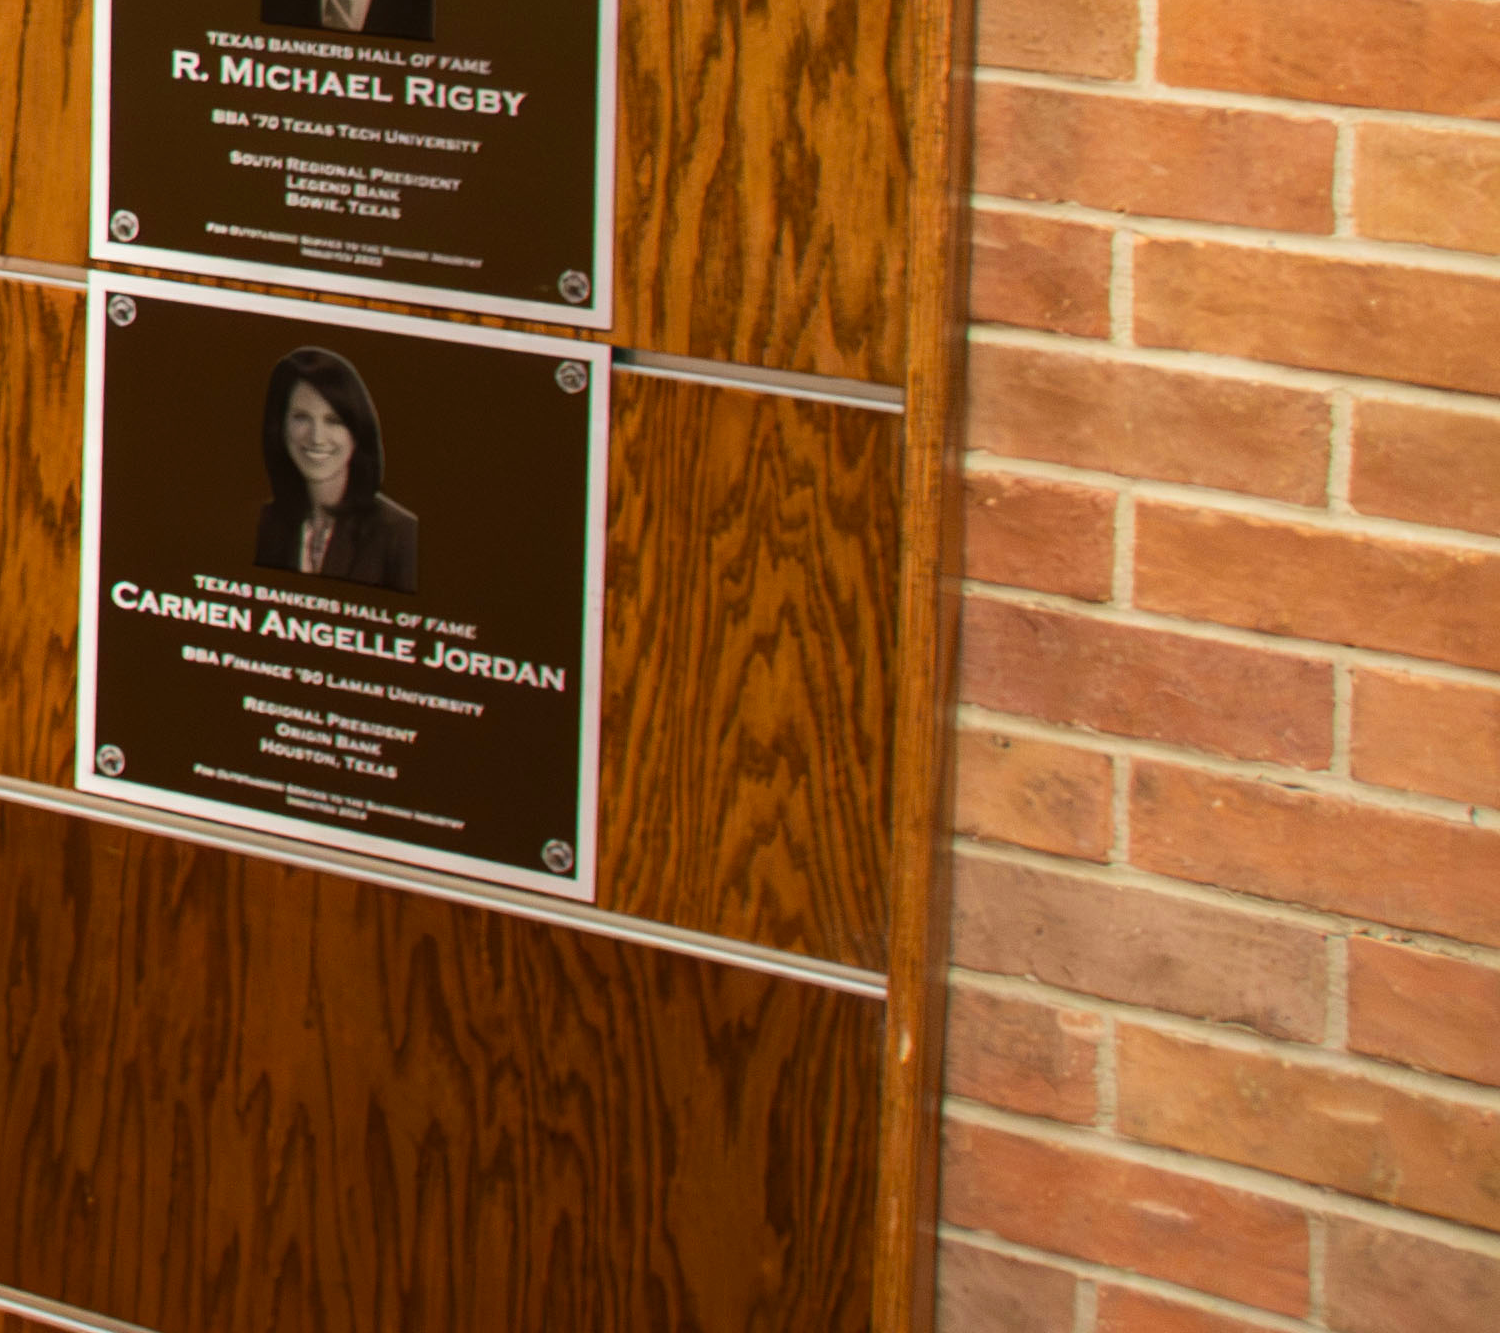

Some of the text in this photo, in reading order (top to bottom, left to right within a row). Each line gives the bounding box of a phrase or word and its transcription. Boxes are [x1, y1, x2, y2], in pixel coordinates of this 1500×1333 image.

[171, 49, 525, 116] R. MICHAEL RIGBY
[110, 580, 564, 691] CARMEN ANGELLE JORDAN
